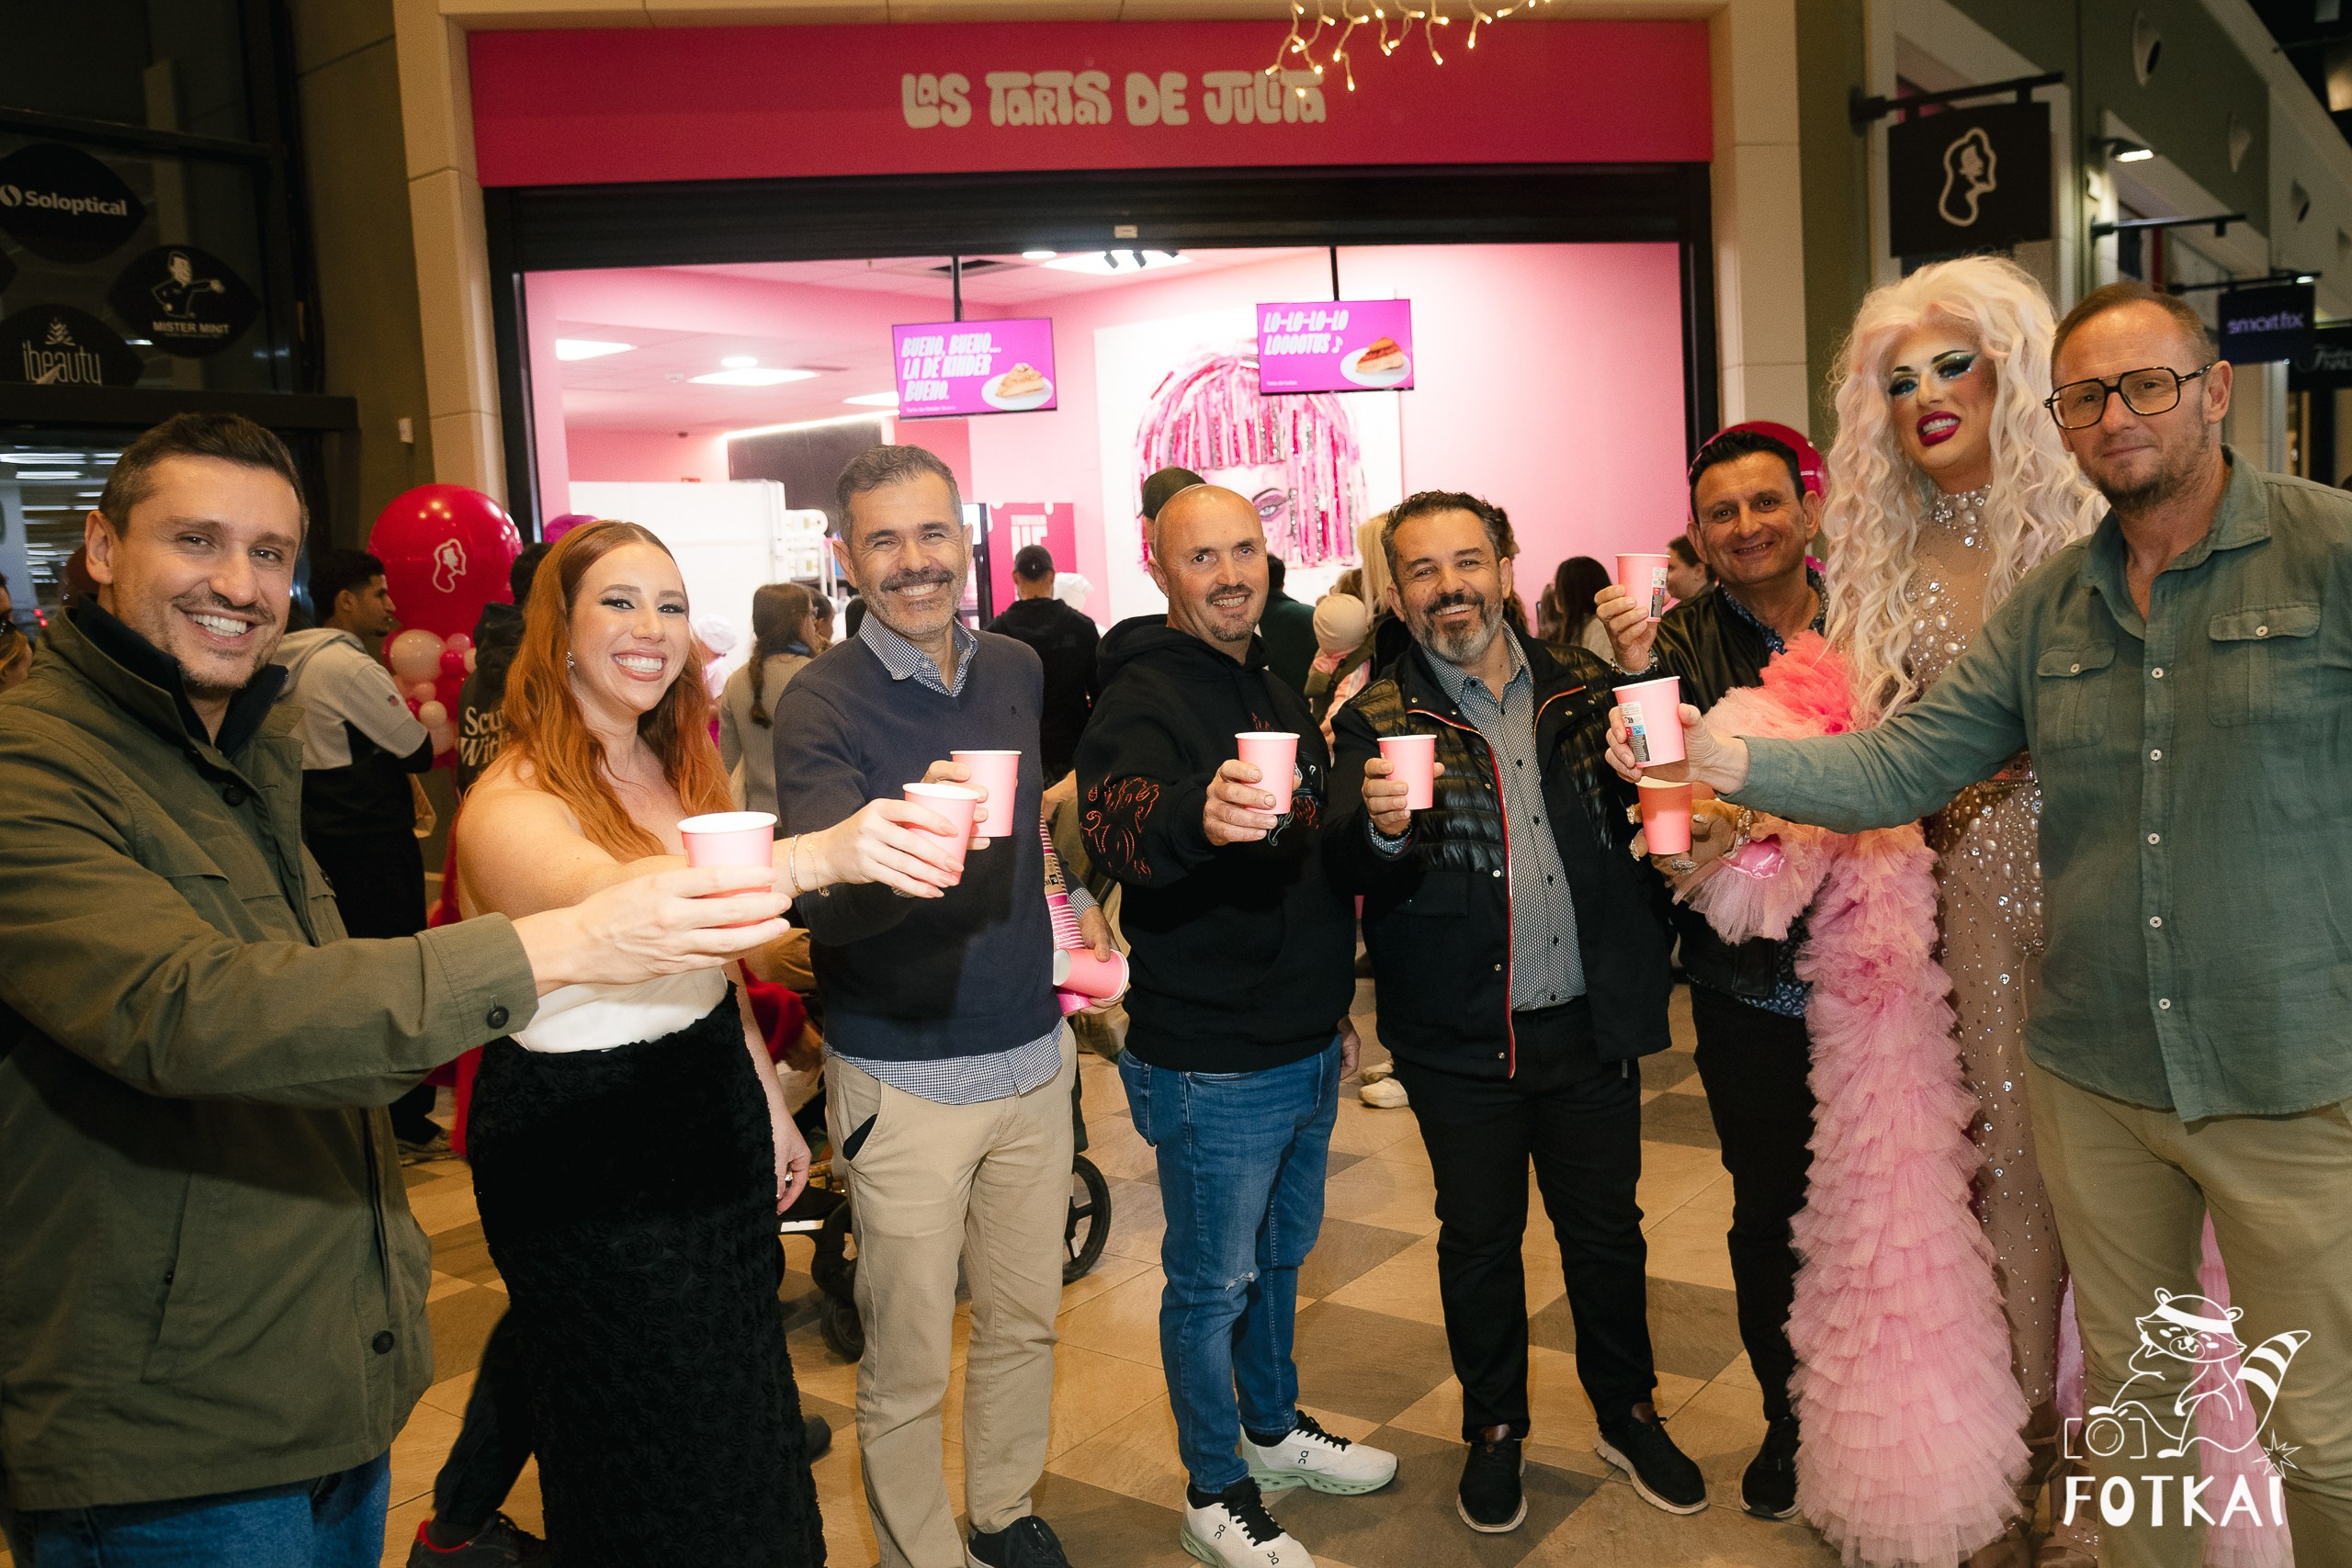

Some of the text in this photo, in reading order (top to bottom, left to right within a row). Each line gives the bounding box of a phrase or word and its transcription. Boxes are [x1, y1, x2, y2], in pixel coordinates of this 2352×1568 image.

[1125, 72, 1190, 127] DE
[26, 191, 128, 216] Soloptical
[153, 321, 198, 333] MISTER
[1263, 310, 1350, 333] LO-LO-LO-LO
[901, 335, 946, 359] BUENO,
[902, 354, 993, 380] LA DE KINDER
[904, 380, 950, 402] BUENO.
